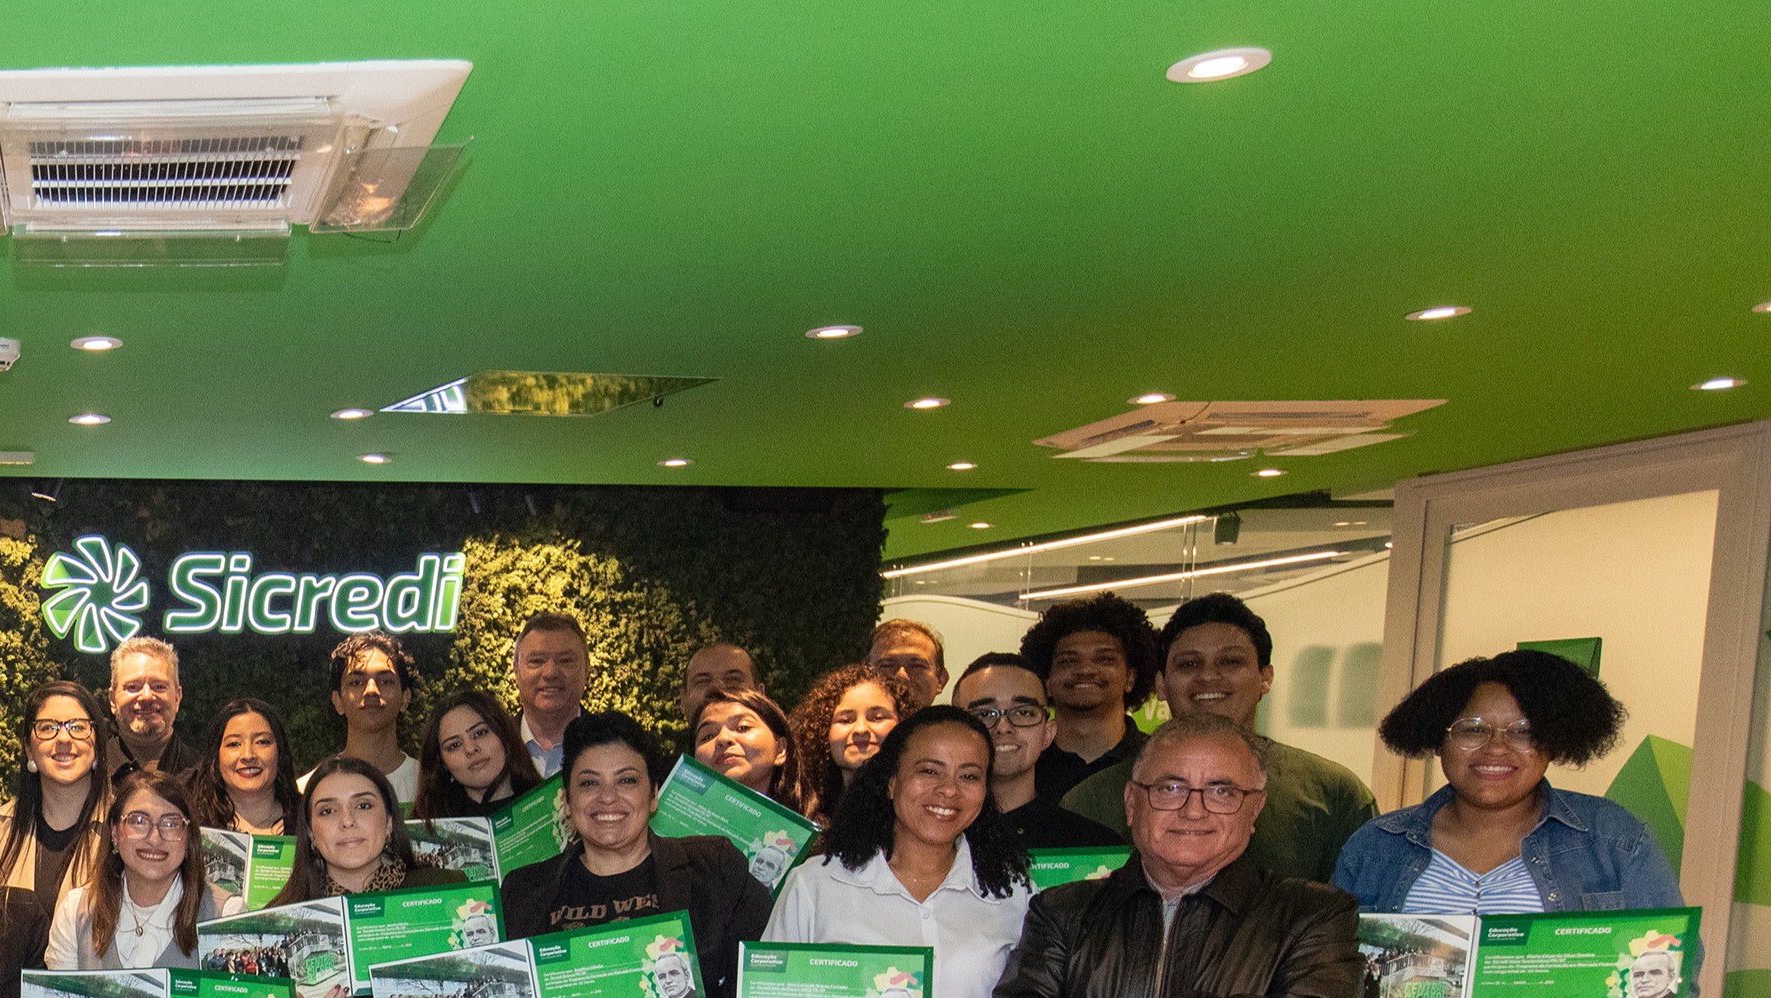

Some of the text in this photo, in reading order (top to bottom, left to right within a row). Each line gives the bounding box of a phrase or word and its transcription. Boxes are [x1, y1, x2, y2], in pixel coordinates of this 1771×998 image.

[163, 552, 465, 633] Sicredi
[402, 898, 442, 908] CERTIFICADO
[550, 905, 607, 925] WILD
[1555, 927, 1612, 936] CERTIFICADO
[588, 936, 629, 948] CERTIFICADO
[809, 958, 858, 967] CERTIFICADO
